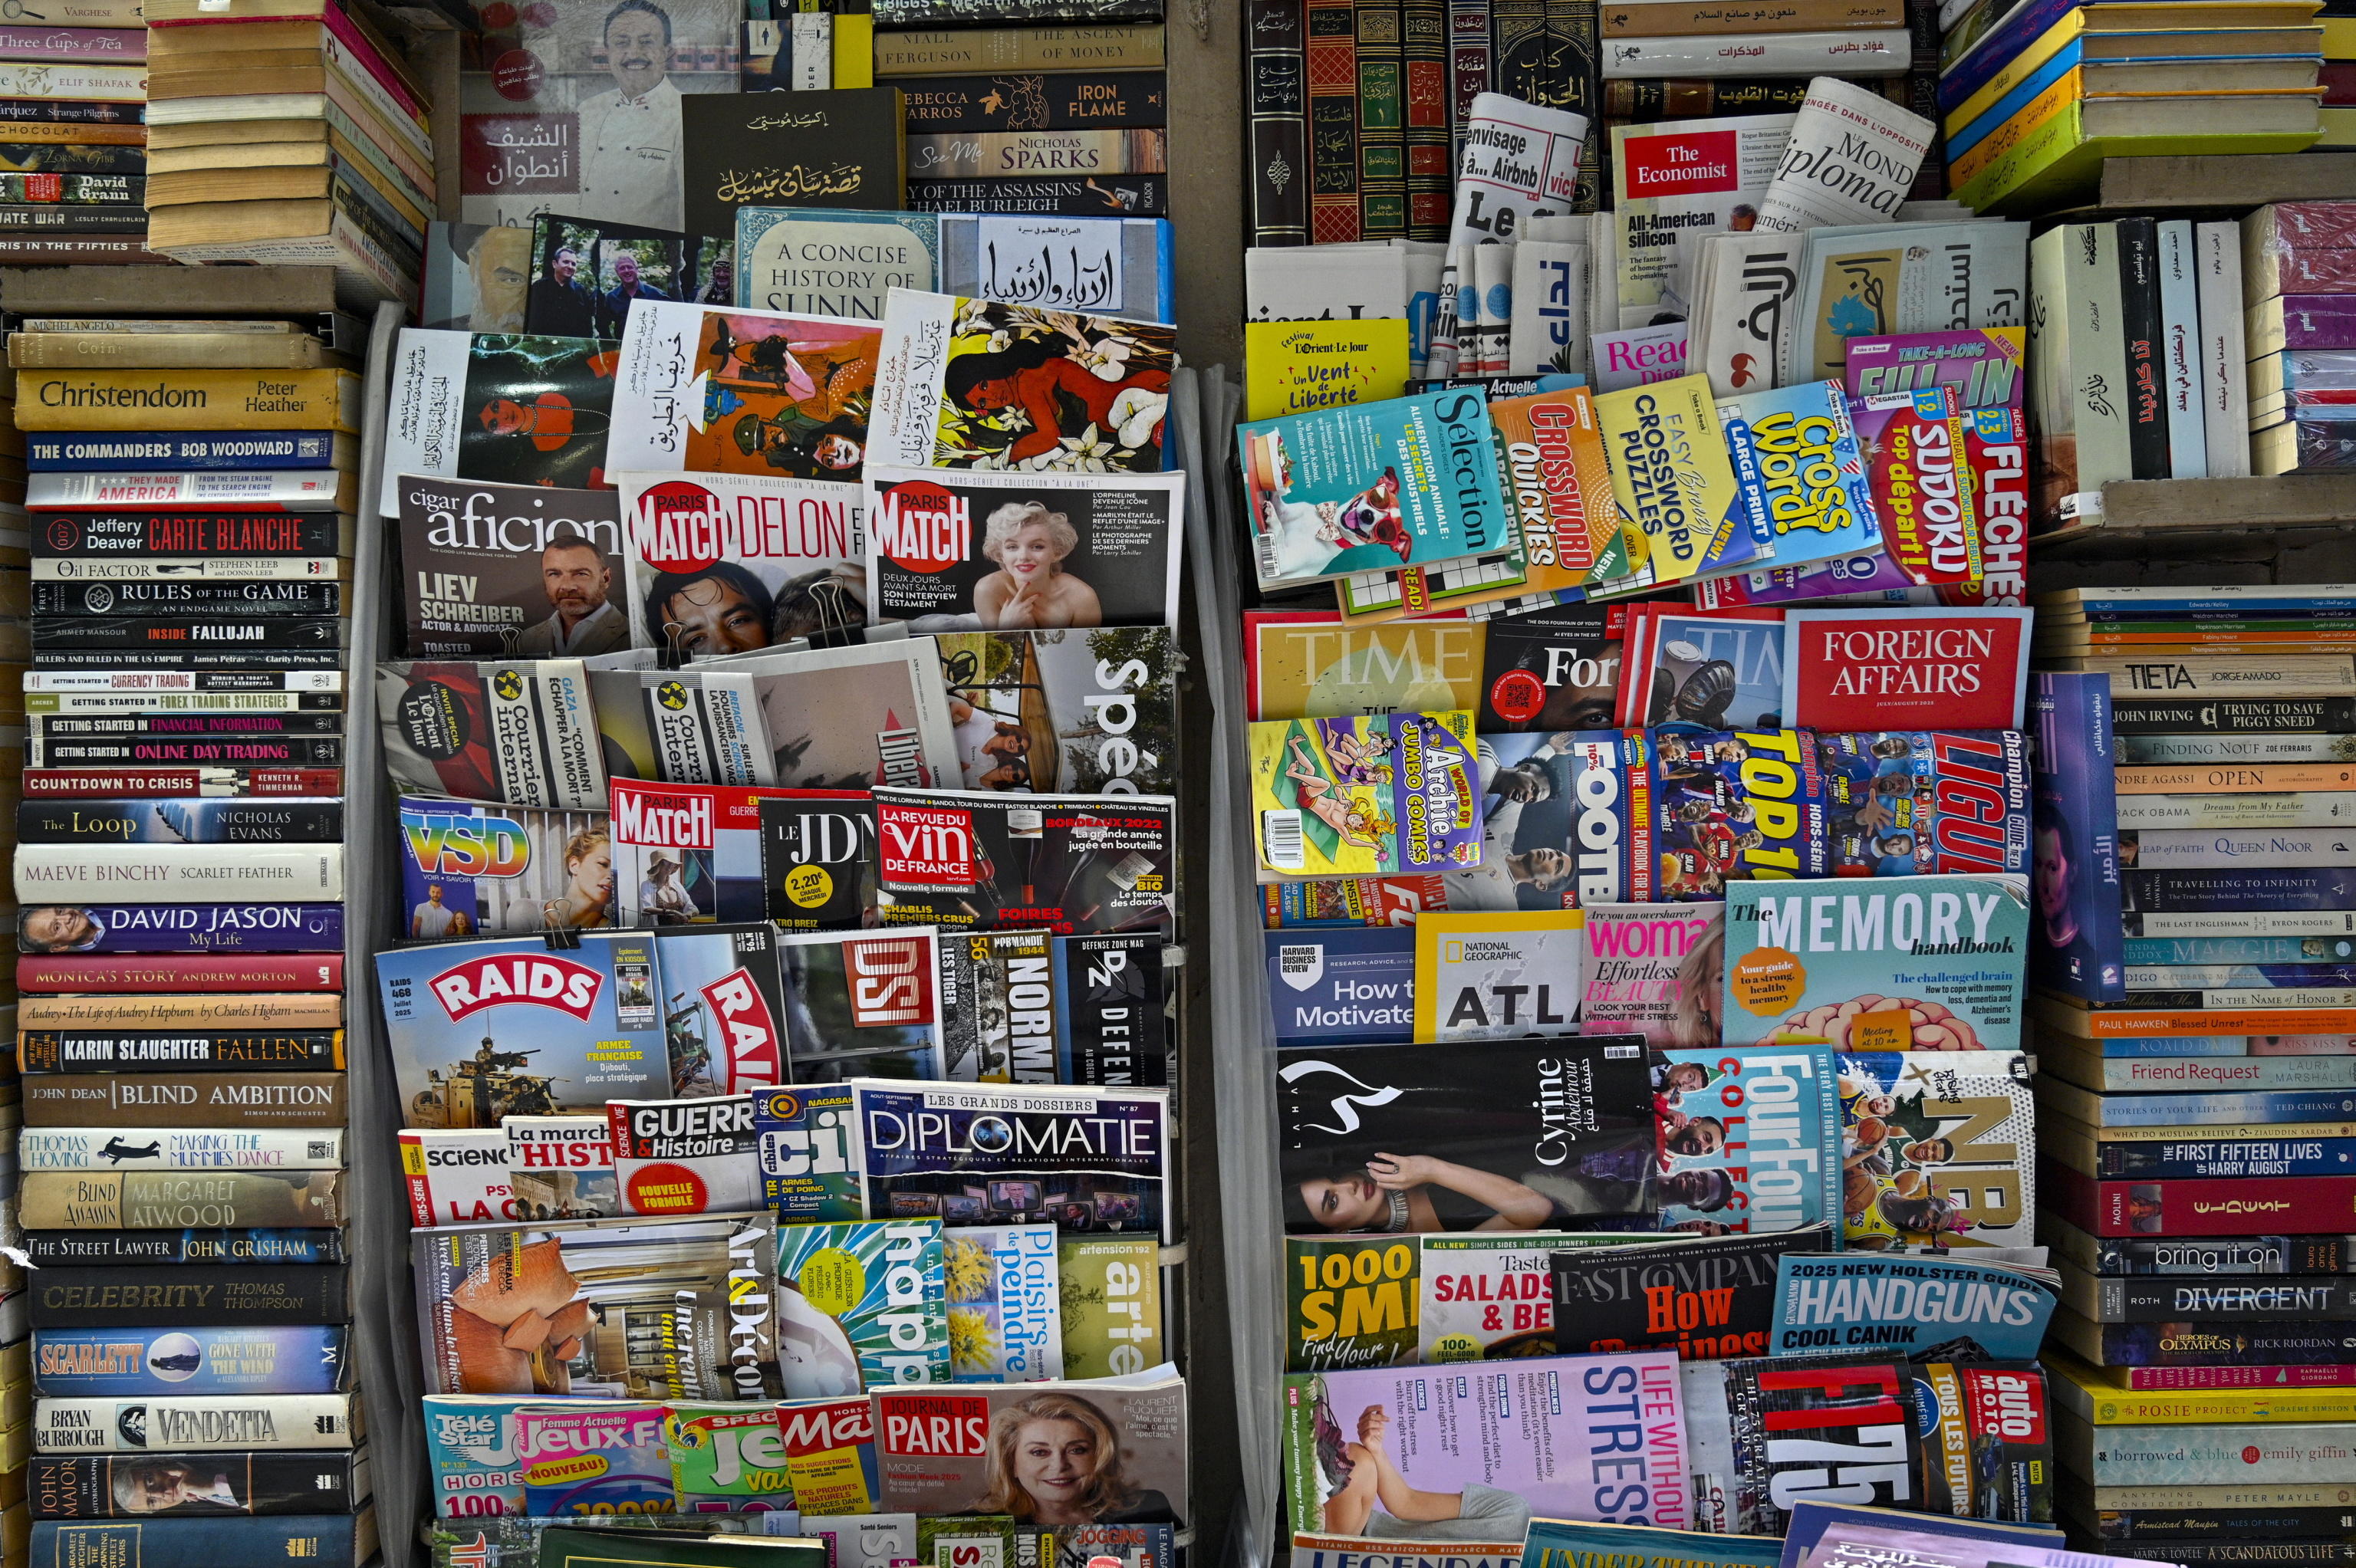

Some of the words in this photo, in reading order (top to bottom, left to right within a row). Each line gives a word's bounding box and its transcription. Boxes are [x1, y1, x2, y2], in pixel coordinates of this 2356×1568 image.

[1718, 43, 1765, 57] المذكرات
[1829, 41, 1860, 54] بطرس
[1862, 41, 1884, 53] فؤاد
[59, 78, 84, 87] ELIF
[88, 78, 133, 87] SHAFAK
[48, 108, 82, 118] Strange
[84, 109, 120, 119] Pilgrims
[487, 125, 568, 147] الشيف
[1667, 147, 1699, 163] The
[487, 158, 568, 185] أنطوان
[1638, 166, 1727, 184] Economist
[1628, 211, 1715, 232] All-American
[1629, 232, 1676, 248] silicon
[981, 240, 1063, 304] والأنبياء
[1067, 245, 1114, 310] الآباء
[34, 321, 114, 330] MICHELANGELO
[1308, 362, 1350, 382] Vent
[40, 381, 206, 408] Christendom
[258, 381, 297, 396] Peter
[1289, 387, 1357, 408] Liberté
[2137, 363, 2156, 422] كارنينا
[246, 397, 307, 413] Heather
[34, 445, 60, 459] THE
[66, 443, 172, 459] COMMANDERS
[181, 443, 207, 457] BOB
[212, 442, 293, 456] WOODWARD
[1434, 394, 1488, 549] Sélection
[1635, 394, 1693, 561] CROSSWORD
[1528, 403, 1594, 570] CROSSWORD
[1620, 432, 1662, 536] PUZZLES
[410, 488, 459, 511] cigar
[900, 495, 947, 510] PARIS
[1508, 442, 1555, 566] QUICKIES
[1912, 424, 1966, 573] SUDOKU
[87, 520, 141, 535] Jeffery
[150, 518, 208, 551] CARTE
[216, 518, 303, 551] BLANCHE
[87, 536, 143, 549] Deaver
[418, 571, 478, 602] LIEV
[884, 590, 902, 599] SON
[907, 591, 957, 600] INTERVIEW
[420, 601, 524, 623] SCHREIBER
[884, 599, 936, 608] TESTAMENT
[148, 629, 186, 639] INSIDE
[192, 626, 264, 639] FALLUJAH
[1823, 630, 1995, 663] FOREIGN
[1287, 629, 1472, 686] TIME
[1830, 664, 1980, 697] AFFAIRS
[2125, 664, 2196, 689] TIETA
[2211, 672, 2241, 681] JORGE
[2242, 672, 2281, 680] AMADO
[160, 695, 188, 708] FOREX
[192, 695, 230, 708] TRADING
[234, 695, 288, 708] STRATEGIES
[2224, 704, 2269, 716] TRYING
[2272, 704, 2290, 715] TO
[2293, 703, 2324, 715] SAVE
[2233, 715, 2271, 728] PIGGY
[2274, 715, 2315, 727] SNEED
[1403, 721, 1422, 789] JUMBO
[31, 778, 123, 790] COUNTDOWN
[127, 778, 145, 789] TO
[149, 777, 192, 789] CRISIS
[2208, 771, 2263, 786] OPEN
[1426, 748, 1464, 836] Archie
[1046, 818, 1122, 828] BORDEAUX
[1124, 820, 1162, 828] 2022
[1406, 794, 1429, 866] COMICS
[401, 815, 530, 877] VSD
[25, 866, 86, 881] MAEVE
[96, 866, 169, 880] BINCHY
[181, 868, 232, 878] SCARLET
[239, 867, 293, 878] FEATHER
[890, 883, 930, 892] Nouvelle
[932, 883, 969, 893] formule
[112, 909, 197, 929] DAVID
[206, 908, 301, 932] JASON
[1732, 905, 1772, 922] The
[1758, 892, 2001, 952] MEMORY
[1082, 939, 1110, 950] DÉFENSE
[1111, 939, 1128, 949] ZONE
[1131, 939, 1144, 948] MAG
[1282, 948, 1315, 956] HARVARD
[1466, 943, 1510, 952] NATIONAL
[1910, 937, 2015, 955] handbook
[1282, 956, 1316, 965] BUSINESS
[1465, 952, 1522, 961] GEOGRAPHIC
[1282, 964, 1308, 972] REVIEW
[1595, 962, 1679, 985] Effortless
[1893, 974, 1913, 983] The
[1917, 971, 1977, 984] challenged
[1982, 971, 2014, 982] brain
[437, 961, 597, 1014] RAIDS
[2099, 1020, 2122, 1029] PAUL
[2125, 1019, 2168, 1028] HAWKEN
[2172, 1019, 2207, 1028] Blessed
[2211, 1018, 2244, 1027] Unrest
[2132, 1063, 2185, 1079] Friend
[2189, 1063, 2259, 1083] Request
[123, 1086, 198, 1104] BLIND
[209, 1086, 333, 1104] AMBITION
[929, 1095, 956, 1107] LES
[961, 1096, 1018, 1110] GRANDS
[1023, 1097, 1093, 1111] DOSSIERS
[1562, 1058, 1582, 1131] Abdelnour
[1535, 1058, 1566, 1166] Cyrine
[870, 1110, 1156, 1155] DIPLOMATIE
[638, 1183, 693, 1195] NOUVELLE
[412, 1178, 431, 1225] HORS-SÉRIE
[643, 1195, 693, 1208] FORMULE
[2155, 1245, 2218, 1272] bring
[2227, 1244, 2240, 1264] it
[2248, 1246, 2279, 1264] on
[1025, 1231, 1053, 1345] Plaisirs
[1791, 1265, 1838, 1277] 2025
[1841, 1264, 1885, 1276] NEW
[1890, 1265, 1979, 1280] HOLSTER
[1983, 1273, 2043, 1294] GUIDE
[43, 1285, 214, 1307] CELEBRITY
[1797, 1277, 2038, 1326] HANDGUNS
[2174, 1287, 2335, 1311] DIVERGENT
[993, 1248, 1026, 1372] peindre
[40, 1344, 143, 1374] SCARLETT
[890, 1399, 957, 1415] JOURNAL
[962, 1400, 981, 1415] DE
[51, 1410, 91, 1427] BRYAN
[156, 1409, 279, 1443] VENDETTA
[542, 1418, 581, 1428] Femme
[583, 1416, 627, 1426] Actuelle
[38, 1429, 104, 1445] BURROUGH
[886, 1416, 986, 1454] PARIS
[2114, 1448, 2183, 1461] borrowed
[2190, 1449, 2201, 1460] &
[2207, 1448, 2237, 1460] blue
[2263, 1448, 2303, 1462] emily
[2309, 1445, 2347, 1462] giffin
[529, 1458, 605, 1479] NOUVEAU!
